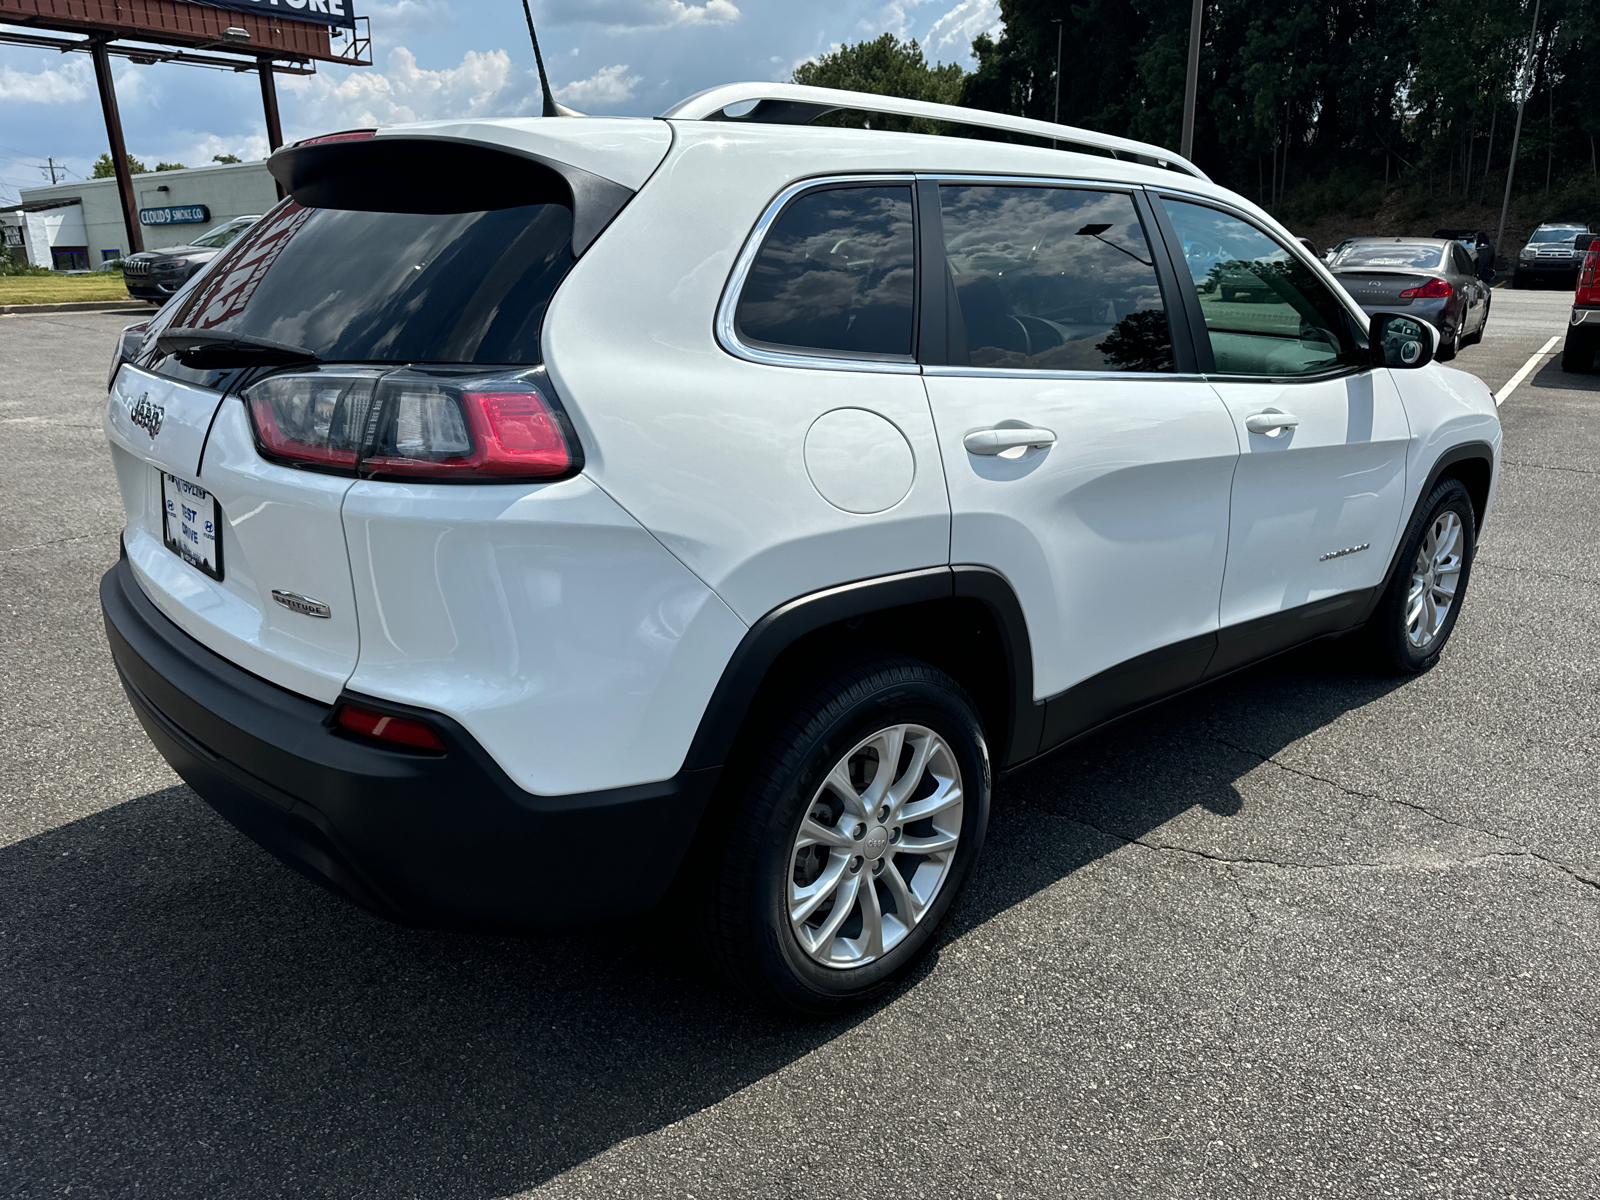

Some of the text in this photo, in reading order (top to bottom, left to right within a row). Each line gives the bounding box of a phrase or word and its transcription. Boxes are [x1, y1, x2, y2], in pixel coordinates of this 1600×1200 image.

[172, 209, 192, 220] SMOKE
[181, 503, 197, 523] TEST
[182, 521, 199, 545] DRIVE
[275, 595, 321, 613] LATITUDE
